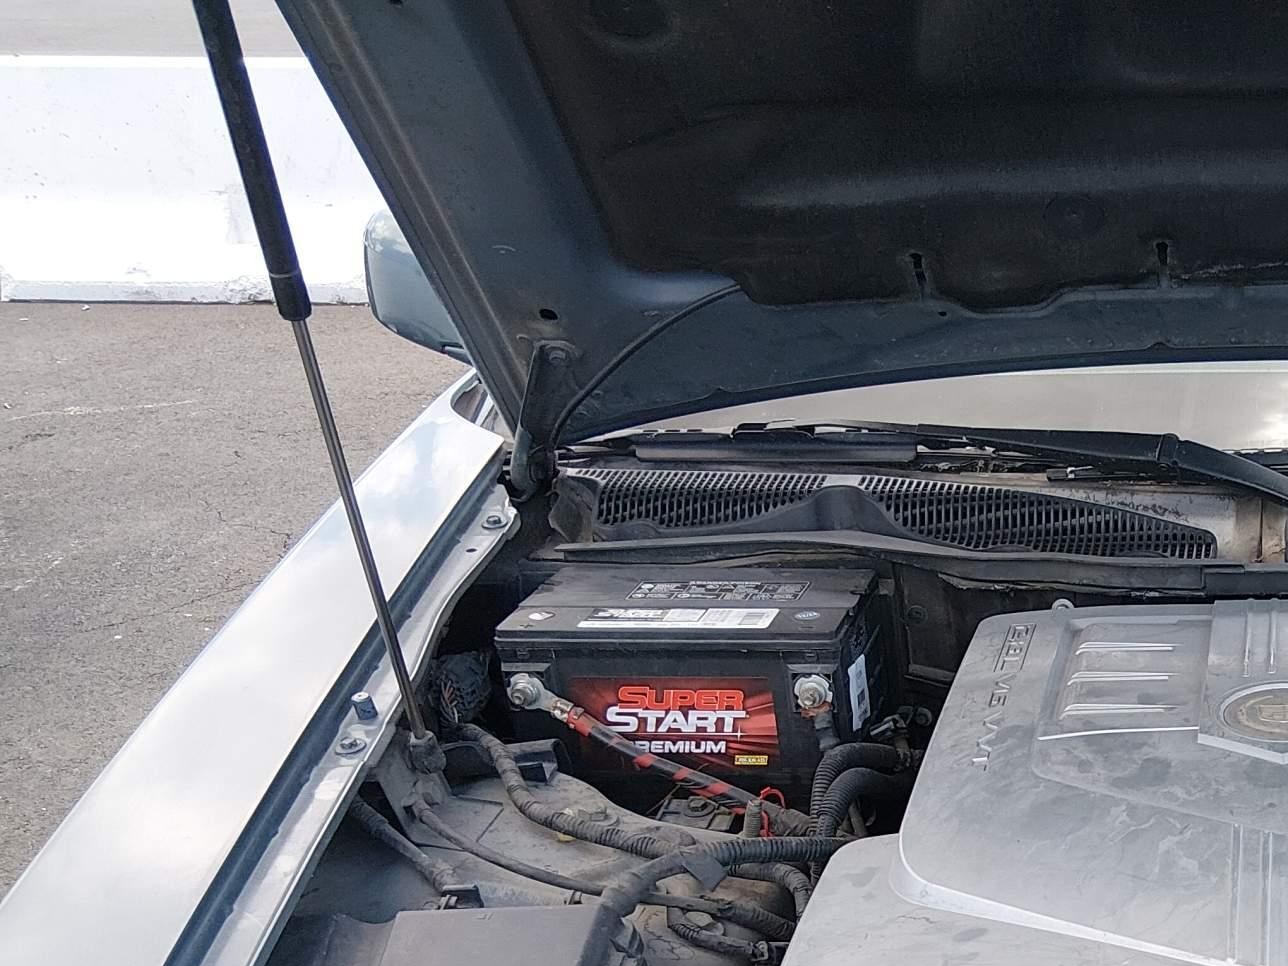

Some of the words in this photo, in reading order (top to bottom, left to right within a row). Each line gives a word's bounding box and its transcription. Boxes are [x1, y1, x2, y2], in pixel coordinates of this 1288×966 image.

[618, 686, 744, 711] SUPER
[988, 673, 1017, 707] V6
[606, 706, 746, 733] START
[630, 740, 727, 754] REMIUM
[972, 710, 1003, 771] VVT
